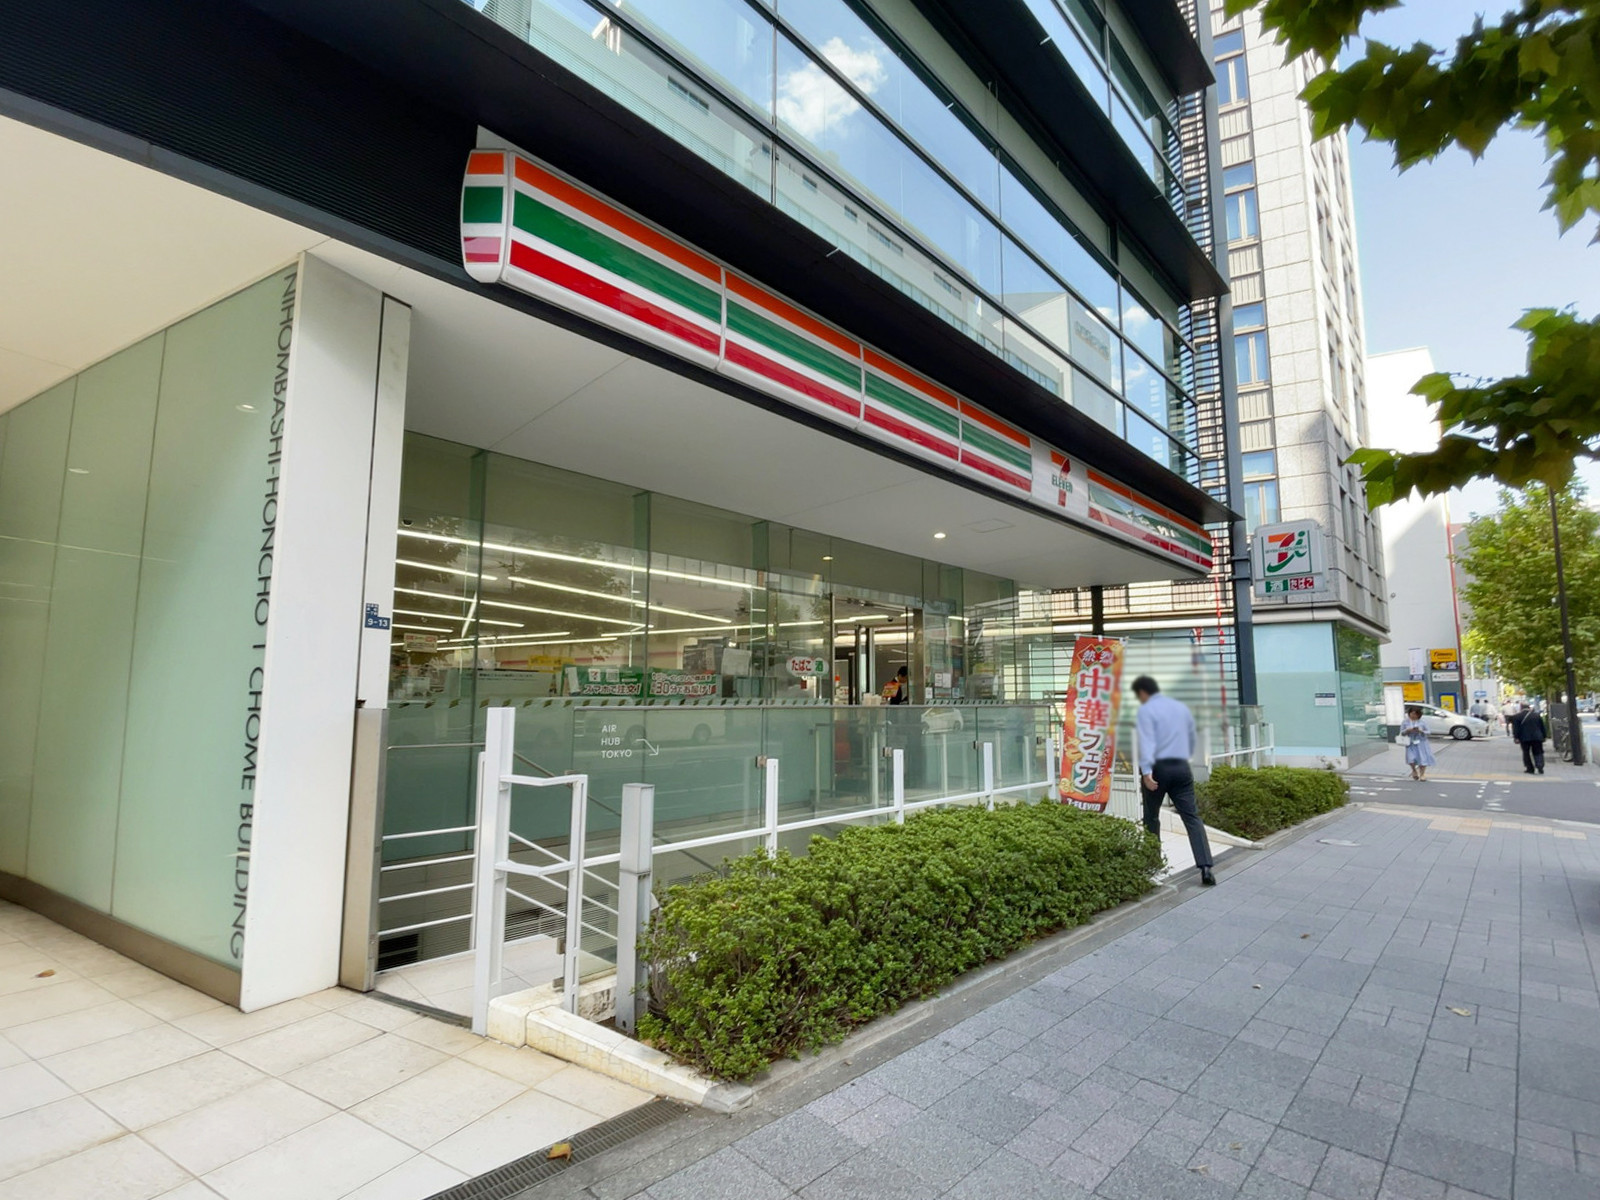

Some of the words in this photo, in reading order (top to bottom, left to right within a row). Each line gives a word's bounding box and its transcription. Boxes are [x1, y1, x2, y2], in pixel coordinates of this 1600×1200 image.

[367, 618, 388, 627] 9-13
[791, 659, 812, 672] たばこ
[815, 660, 824, 672] 酒
[241, 666, 264, 790] CHOME
[601, 724, 617, 733] AIR
[1076, 667, 1112, 786] 中華フェア
[601, 737, 621, 746] HUB
[601, 749, 632, 758] TOKYO
[230, 803, 253, 960] BUILDING
